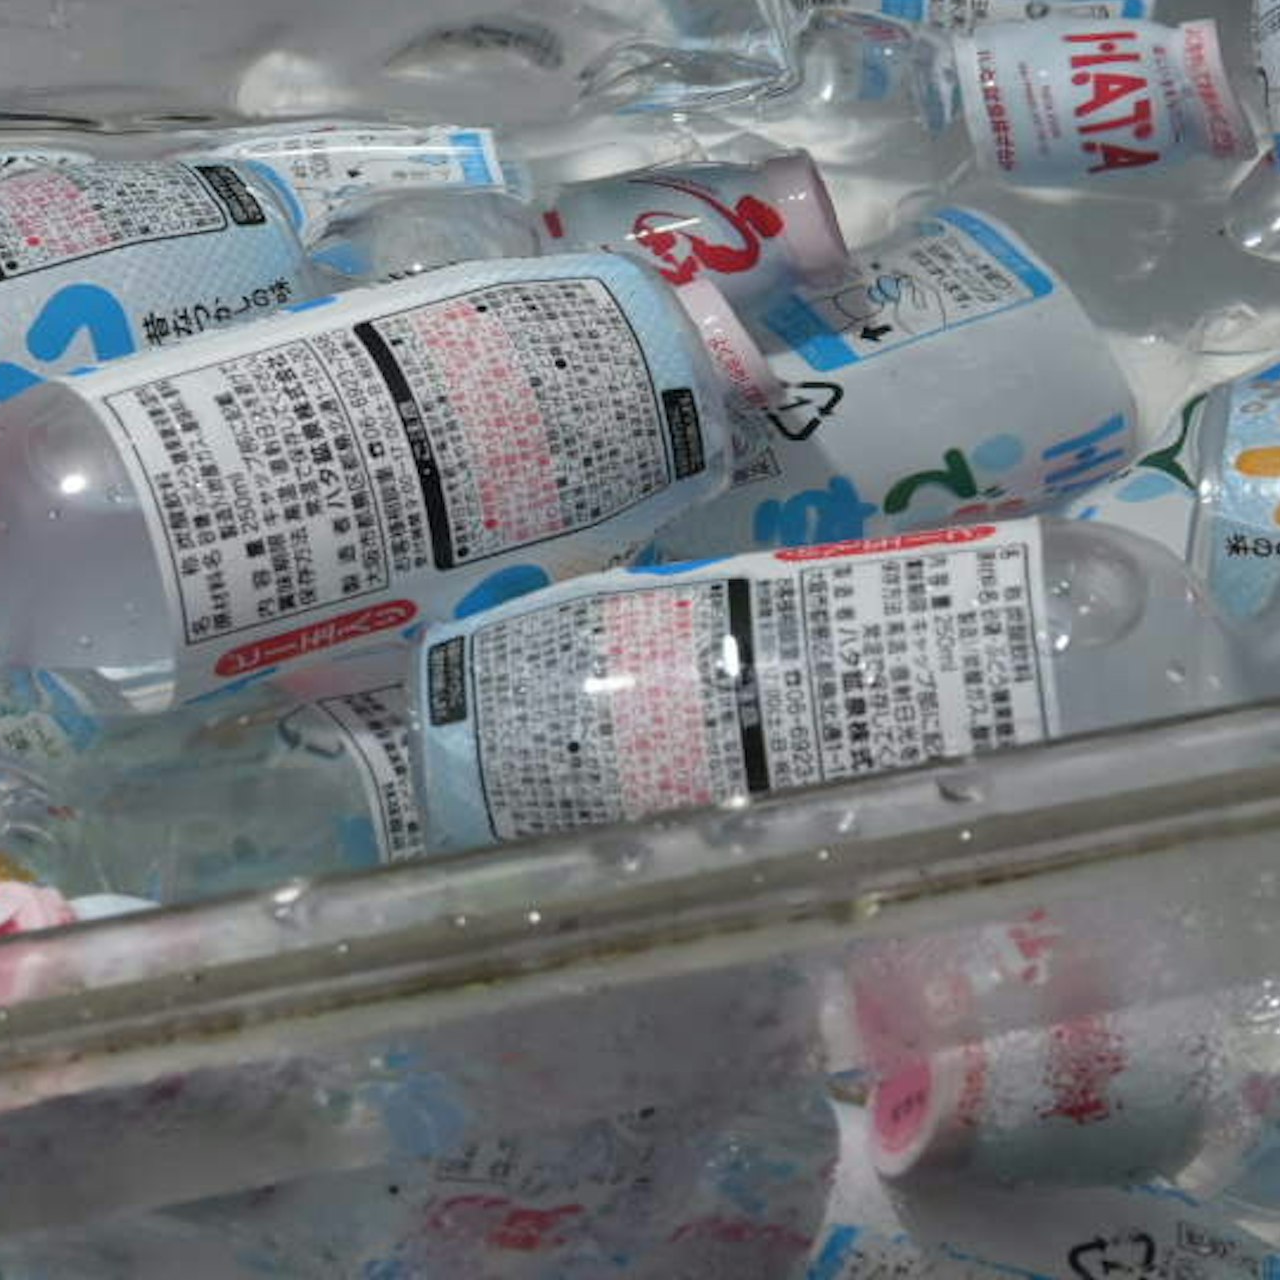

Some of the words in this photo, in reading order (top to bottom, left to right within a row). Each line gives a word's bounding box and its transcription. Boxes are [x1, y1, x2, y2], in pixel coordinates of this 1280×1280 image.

[1062, 30, 1160, 175] HATA
[142, 278, 294, 347] 昔なつかしの味
[227, 471, 261, 535] 250ml
